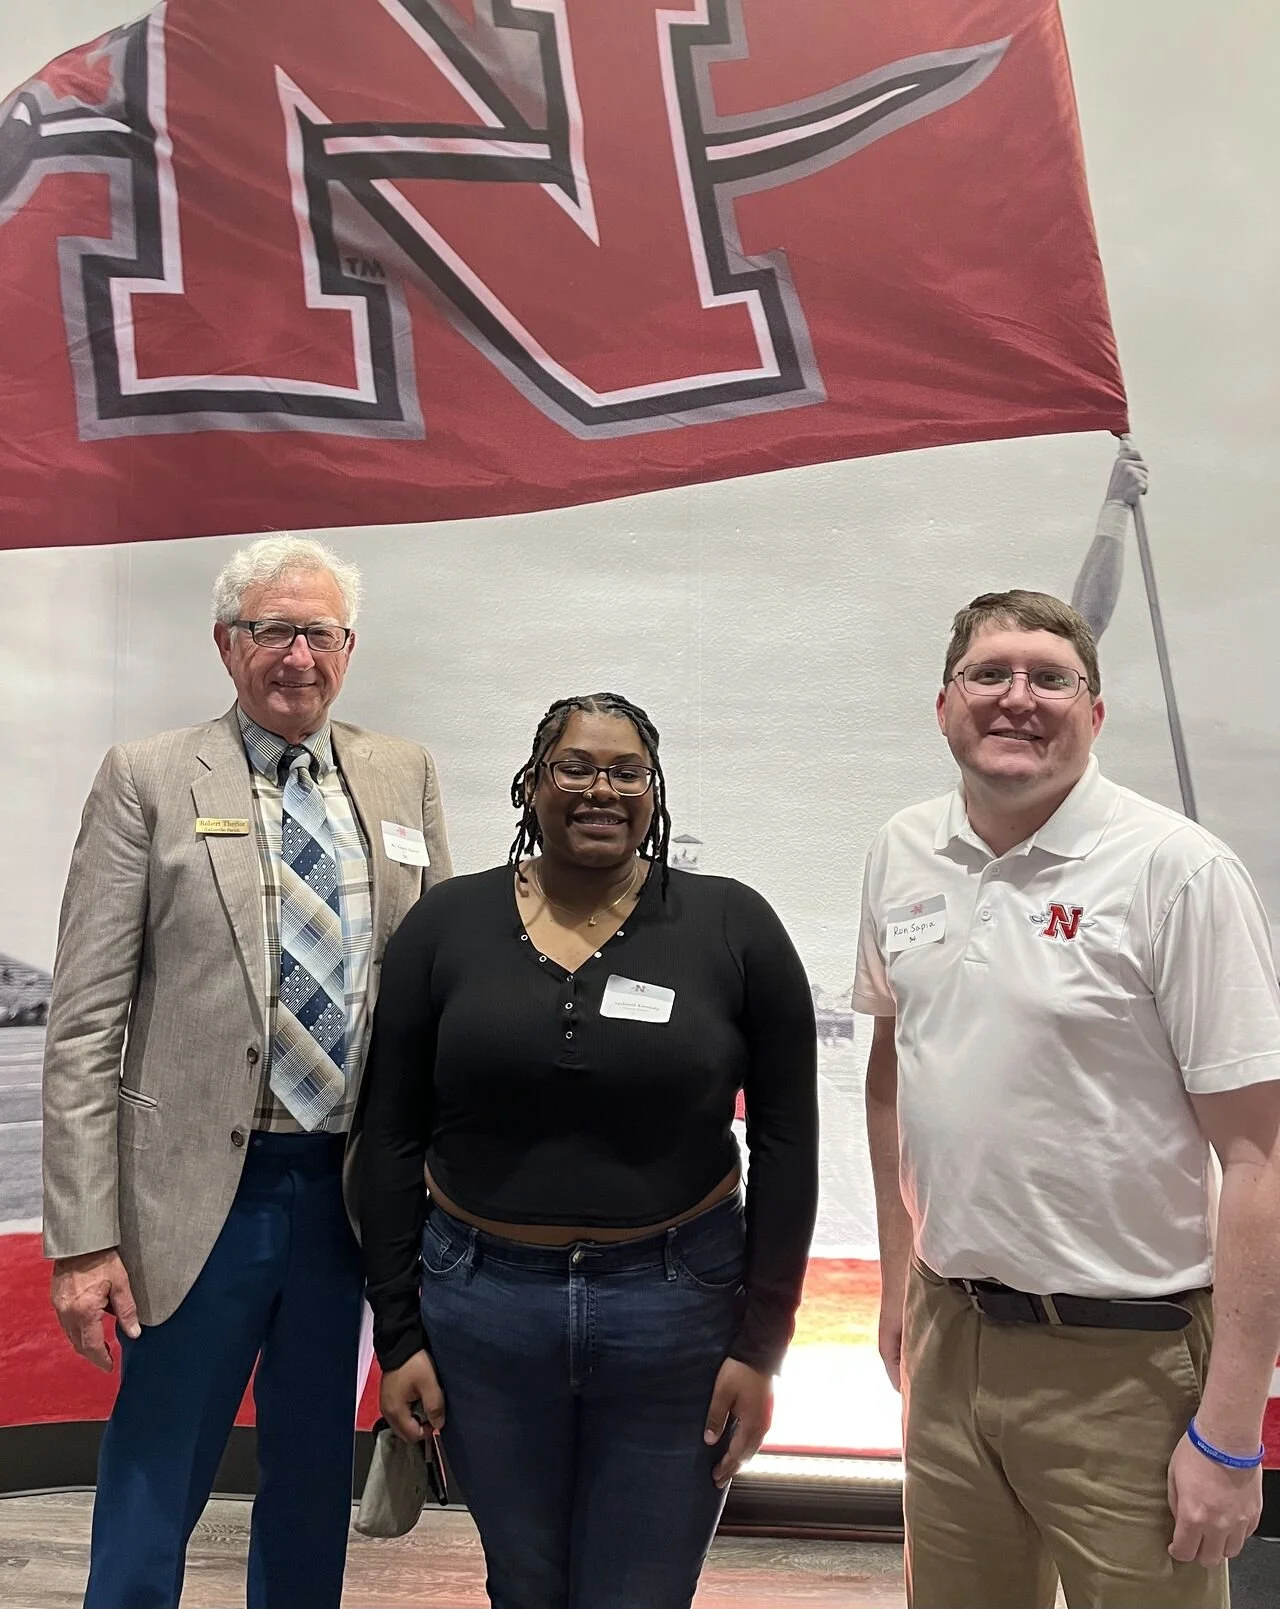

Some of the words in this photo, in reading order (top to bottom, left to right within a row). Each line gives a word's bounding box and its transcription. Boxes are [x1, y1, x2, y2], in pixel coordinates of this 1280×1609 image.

[345, 257, 387, 279] TM
[893, 926, 909, 936] Ron
[911, 922, 936, 933] Sapia
[1040, 900, 1084, 942] N
